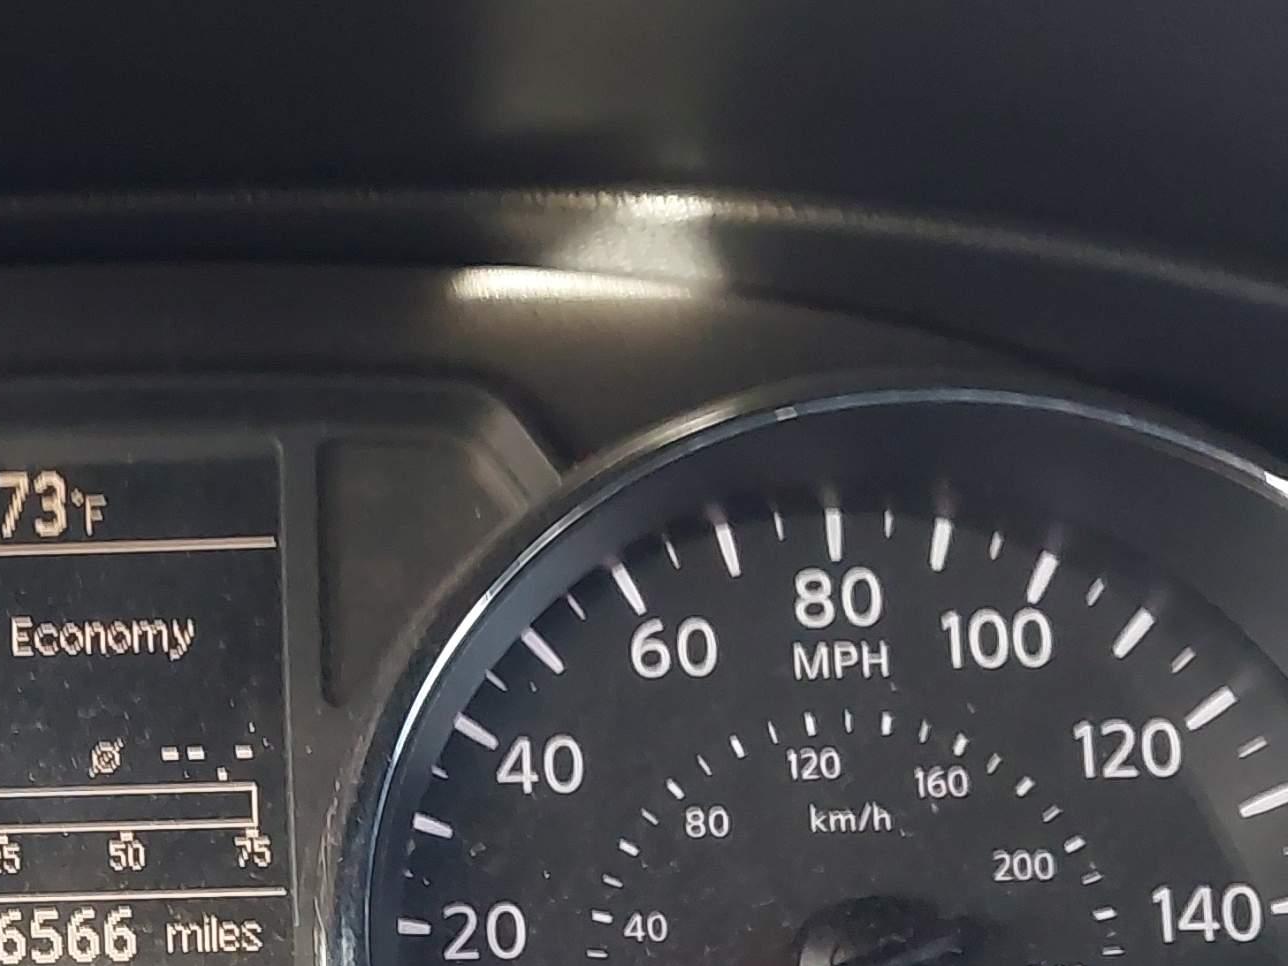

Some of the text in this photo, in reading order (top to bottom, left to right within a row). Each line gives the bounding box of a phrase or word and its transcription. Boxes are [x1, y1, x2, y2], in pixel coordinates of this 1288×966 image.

[795, 567, 883, 628] 80
[11, 615, 195, 660] Economy
[630, 616, 718, 679] 60
[941, 607, 1054, 669] 100
[793, 640, 890, 680] MPH
[496, 734, 584, 794] 40
[787, 748, 841, 781] 120
[1073, 718, 1181, 779] 120
[915, 766, 969, 798] 160
[685, 806, 730, 838] 80
[809, 802, 892, 833] km/h
[108, 840, 146, 871] 50
[234, 837, 272, 868] 75
[993, 850, 1055, 882] 200
[443, 902, 526, 960] 20
[623, 911, 668, 943] 40
[1152, 884, 1262, 943] 140
[166, 914, 264, 954] miles
